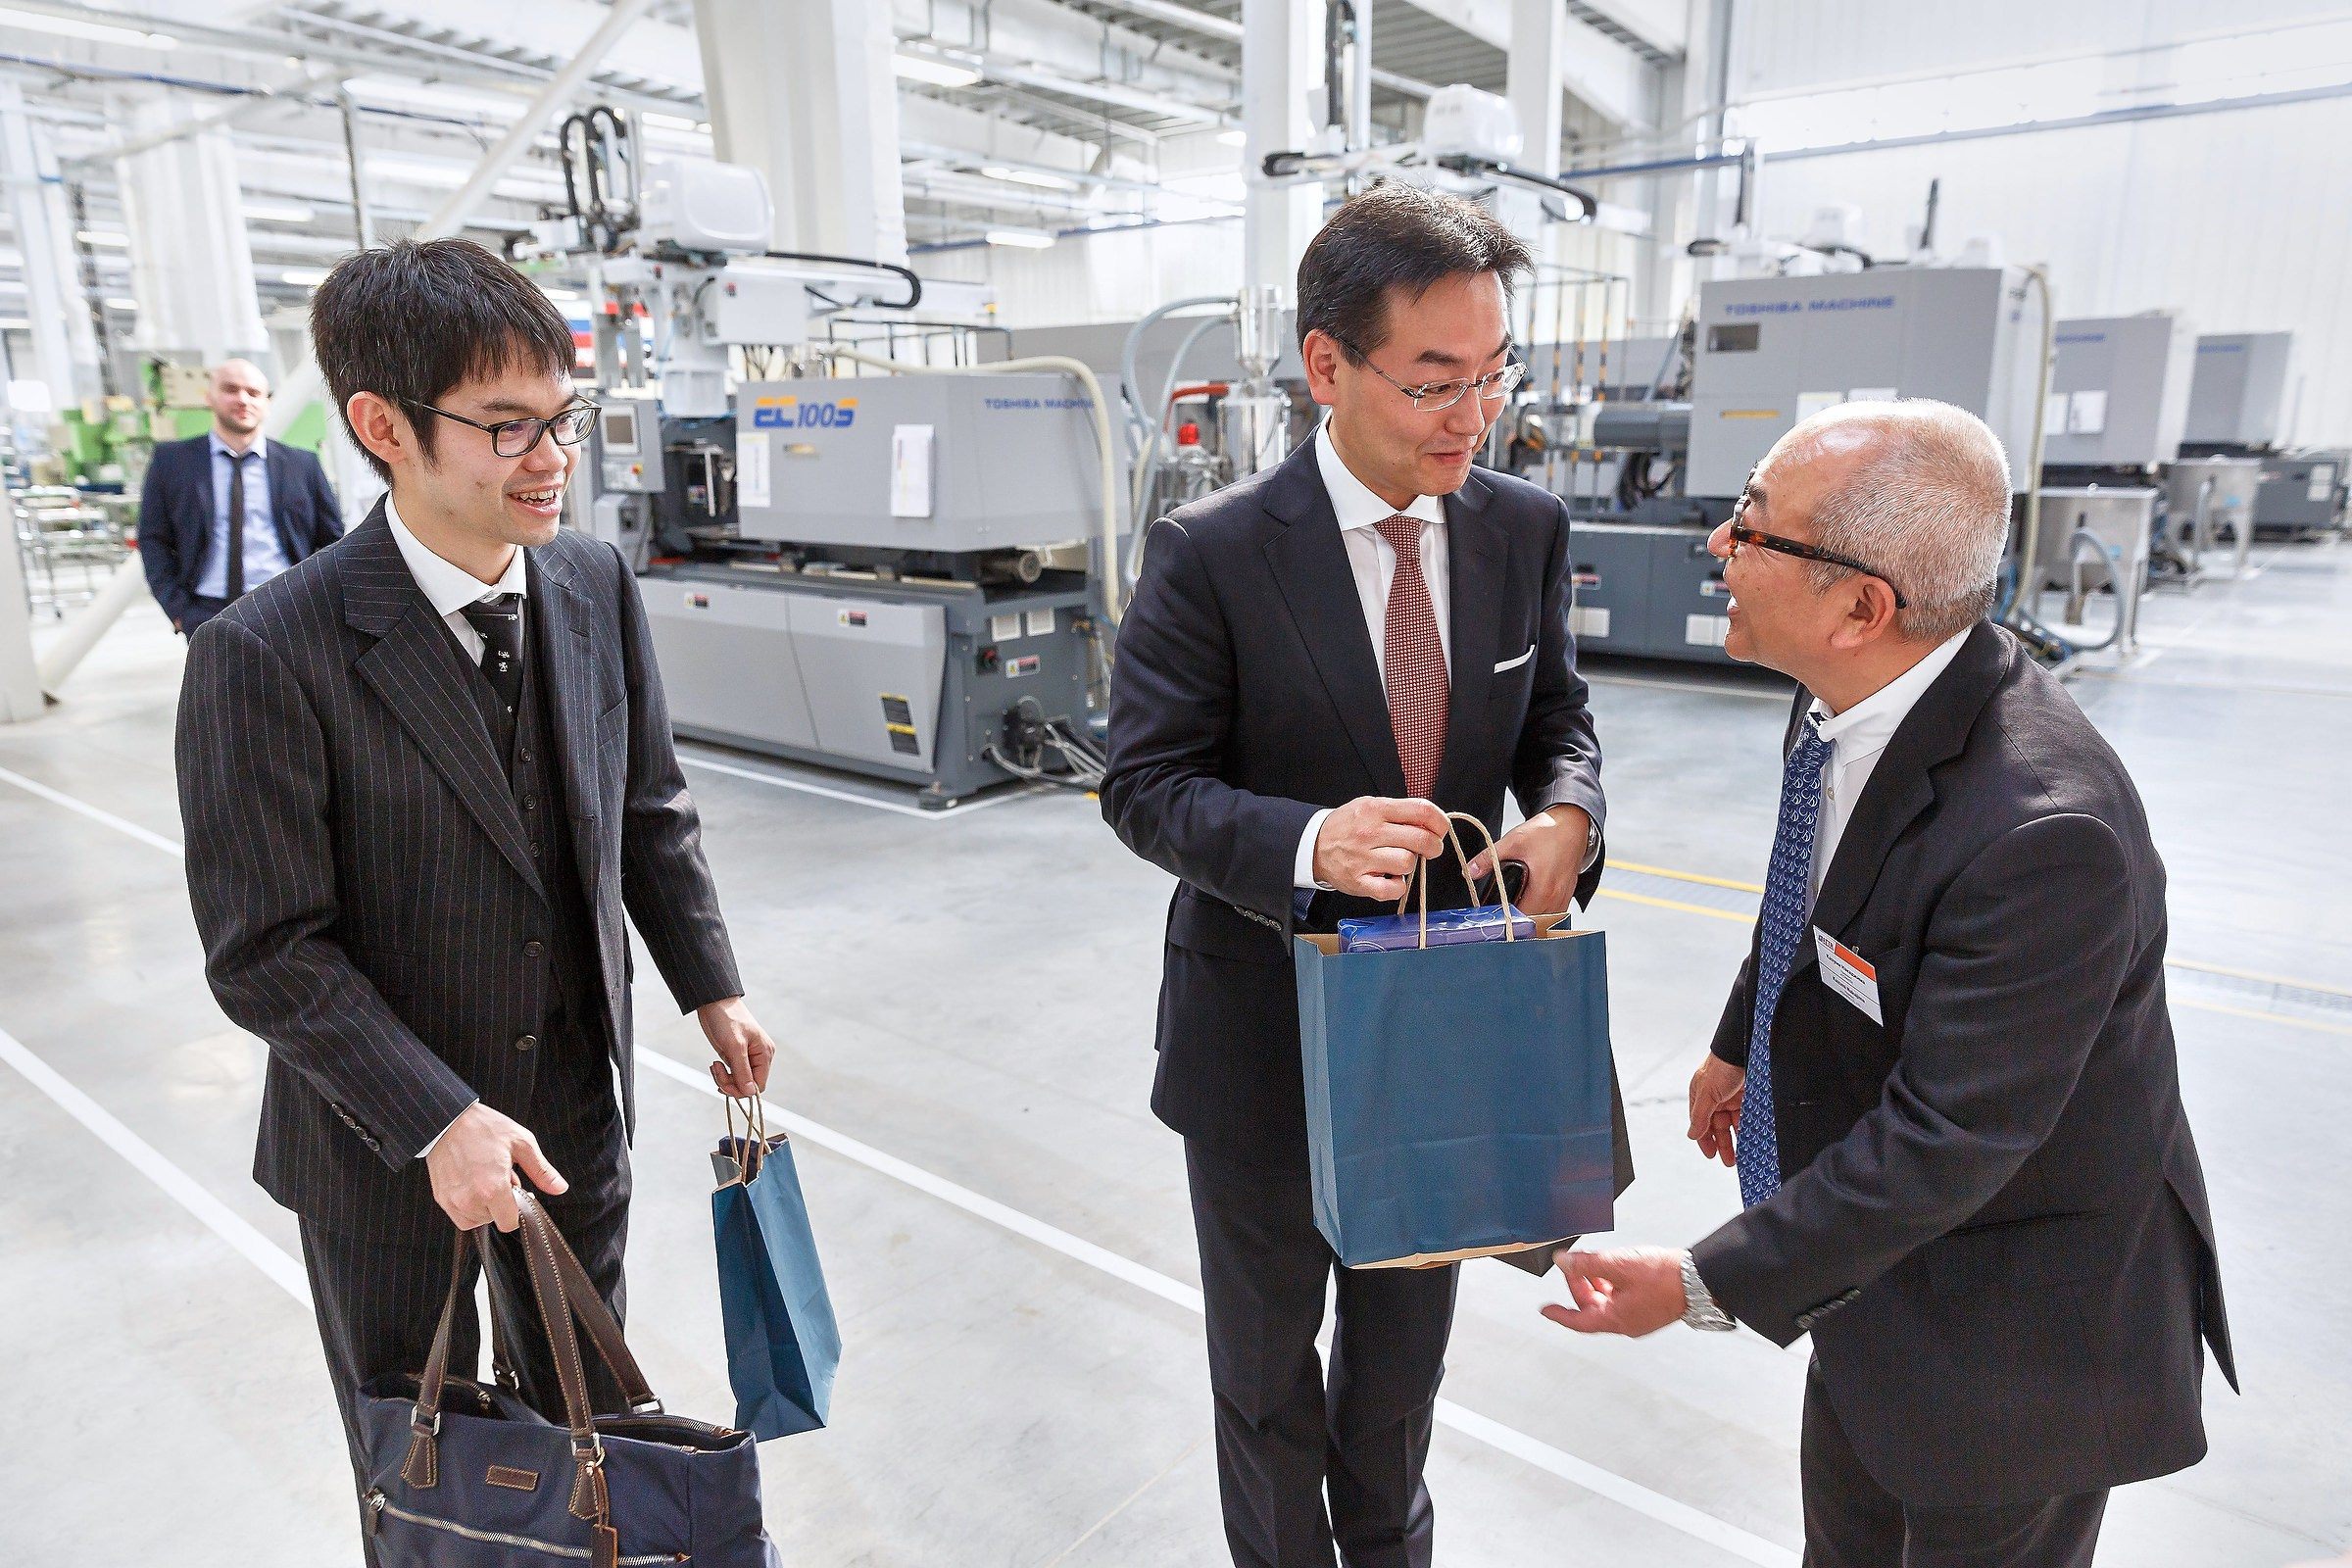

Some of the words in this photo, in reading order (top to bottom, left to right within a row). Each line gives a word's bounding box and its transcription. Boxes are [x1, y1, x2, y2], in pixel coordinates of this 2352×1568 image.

[1725, 302, 1802, 316] TOSHIBA
[1809, 296, 1894, 312] MACHINE
[985, 398, 1041, 409] TOSHIBA
[1044, 398, 1096, 409] MACHIN
